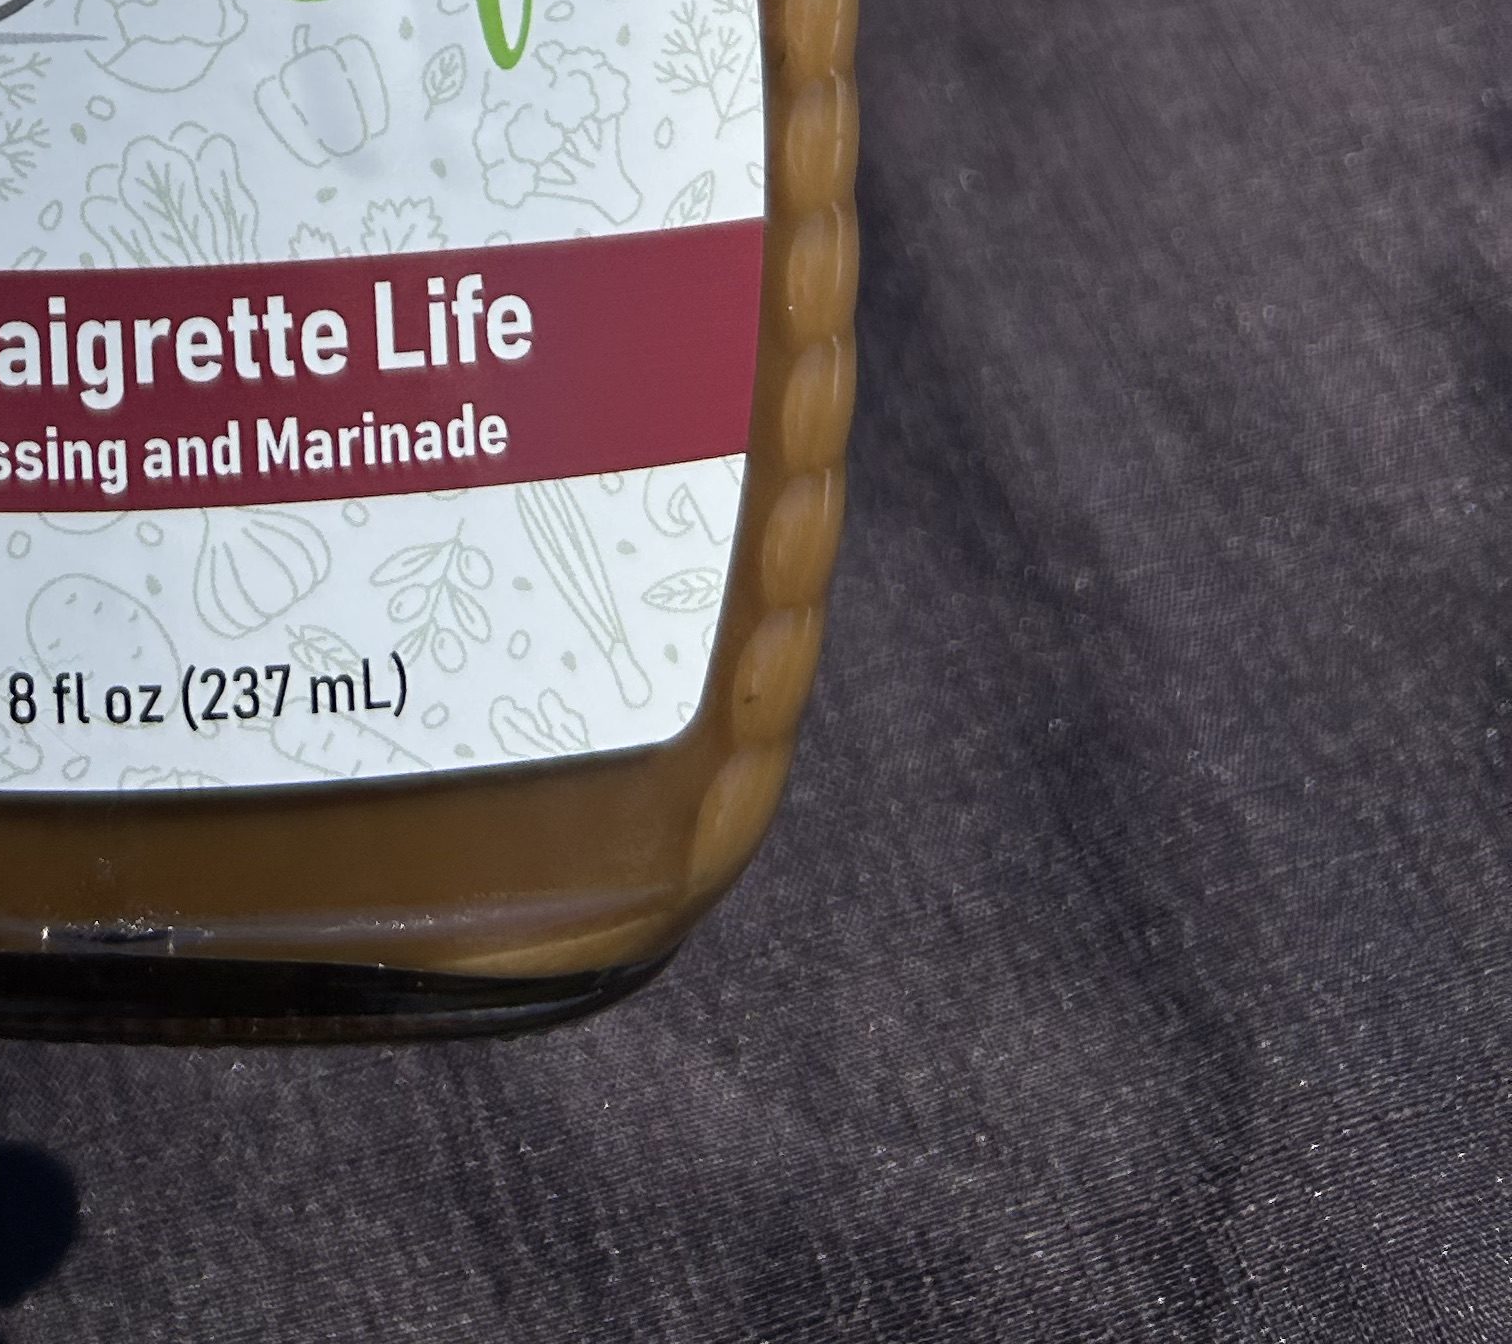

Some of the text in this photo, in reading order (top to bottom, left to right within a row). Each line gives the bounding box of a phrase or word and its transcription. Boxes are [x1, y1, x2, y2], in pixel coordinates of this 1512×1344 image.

[373, 272, 535, 372] Life
[142, 419, 242, 480] and
[255, 401, 510, 474] Marinade
[7, 649, 409, 733] 8 fl oz (237 mL)
